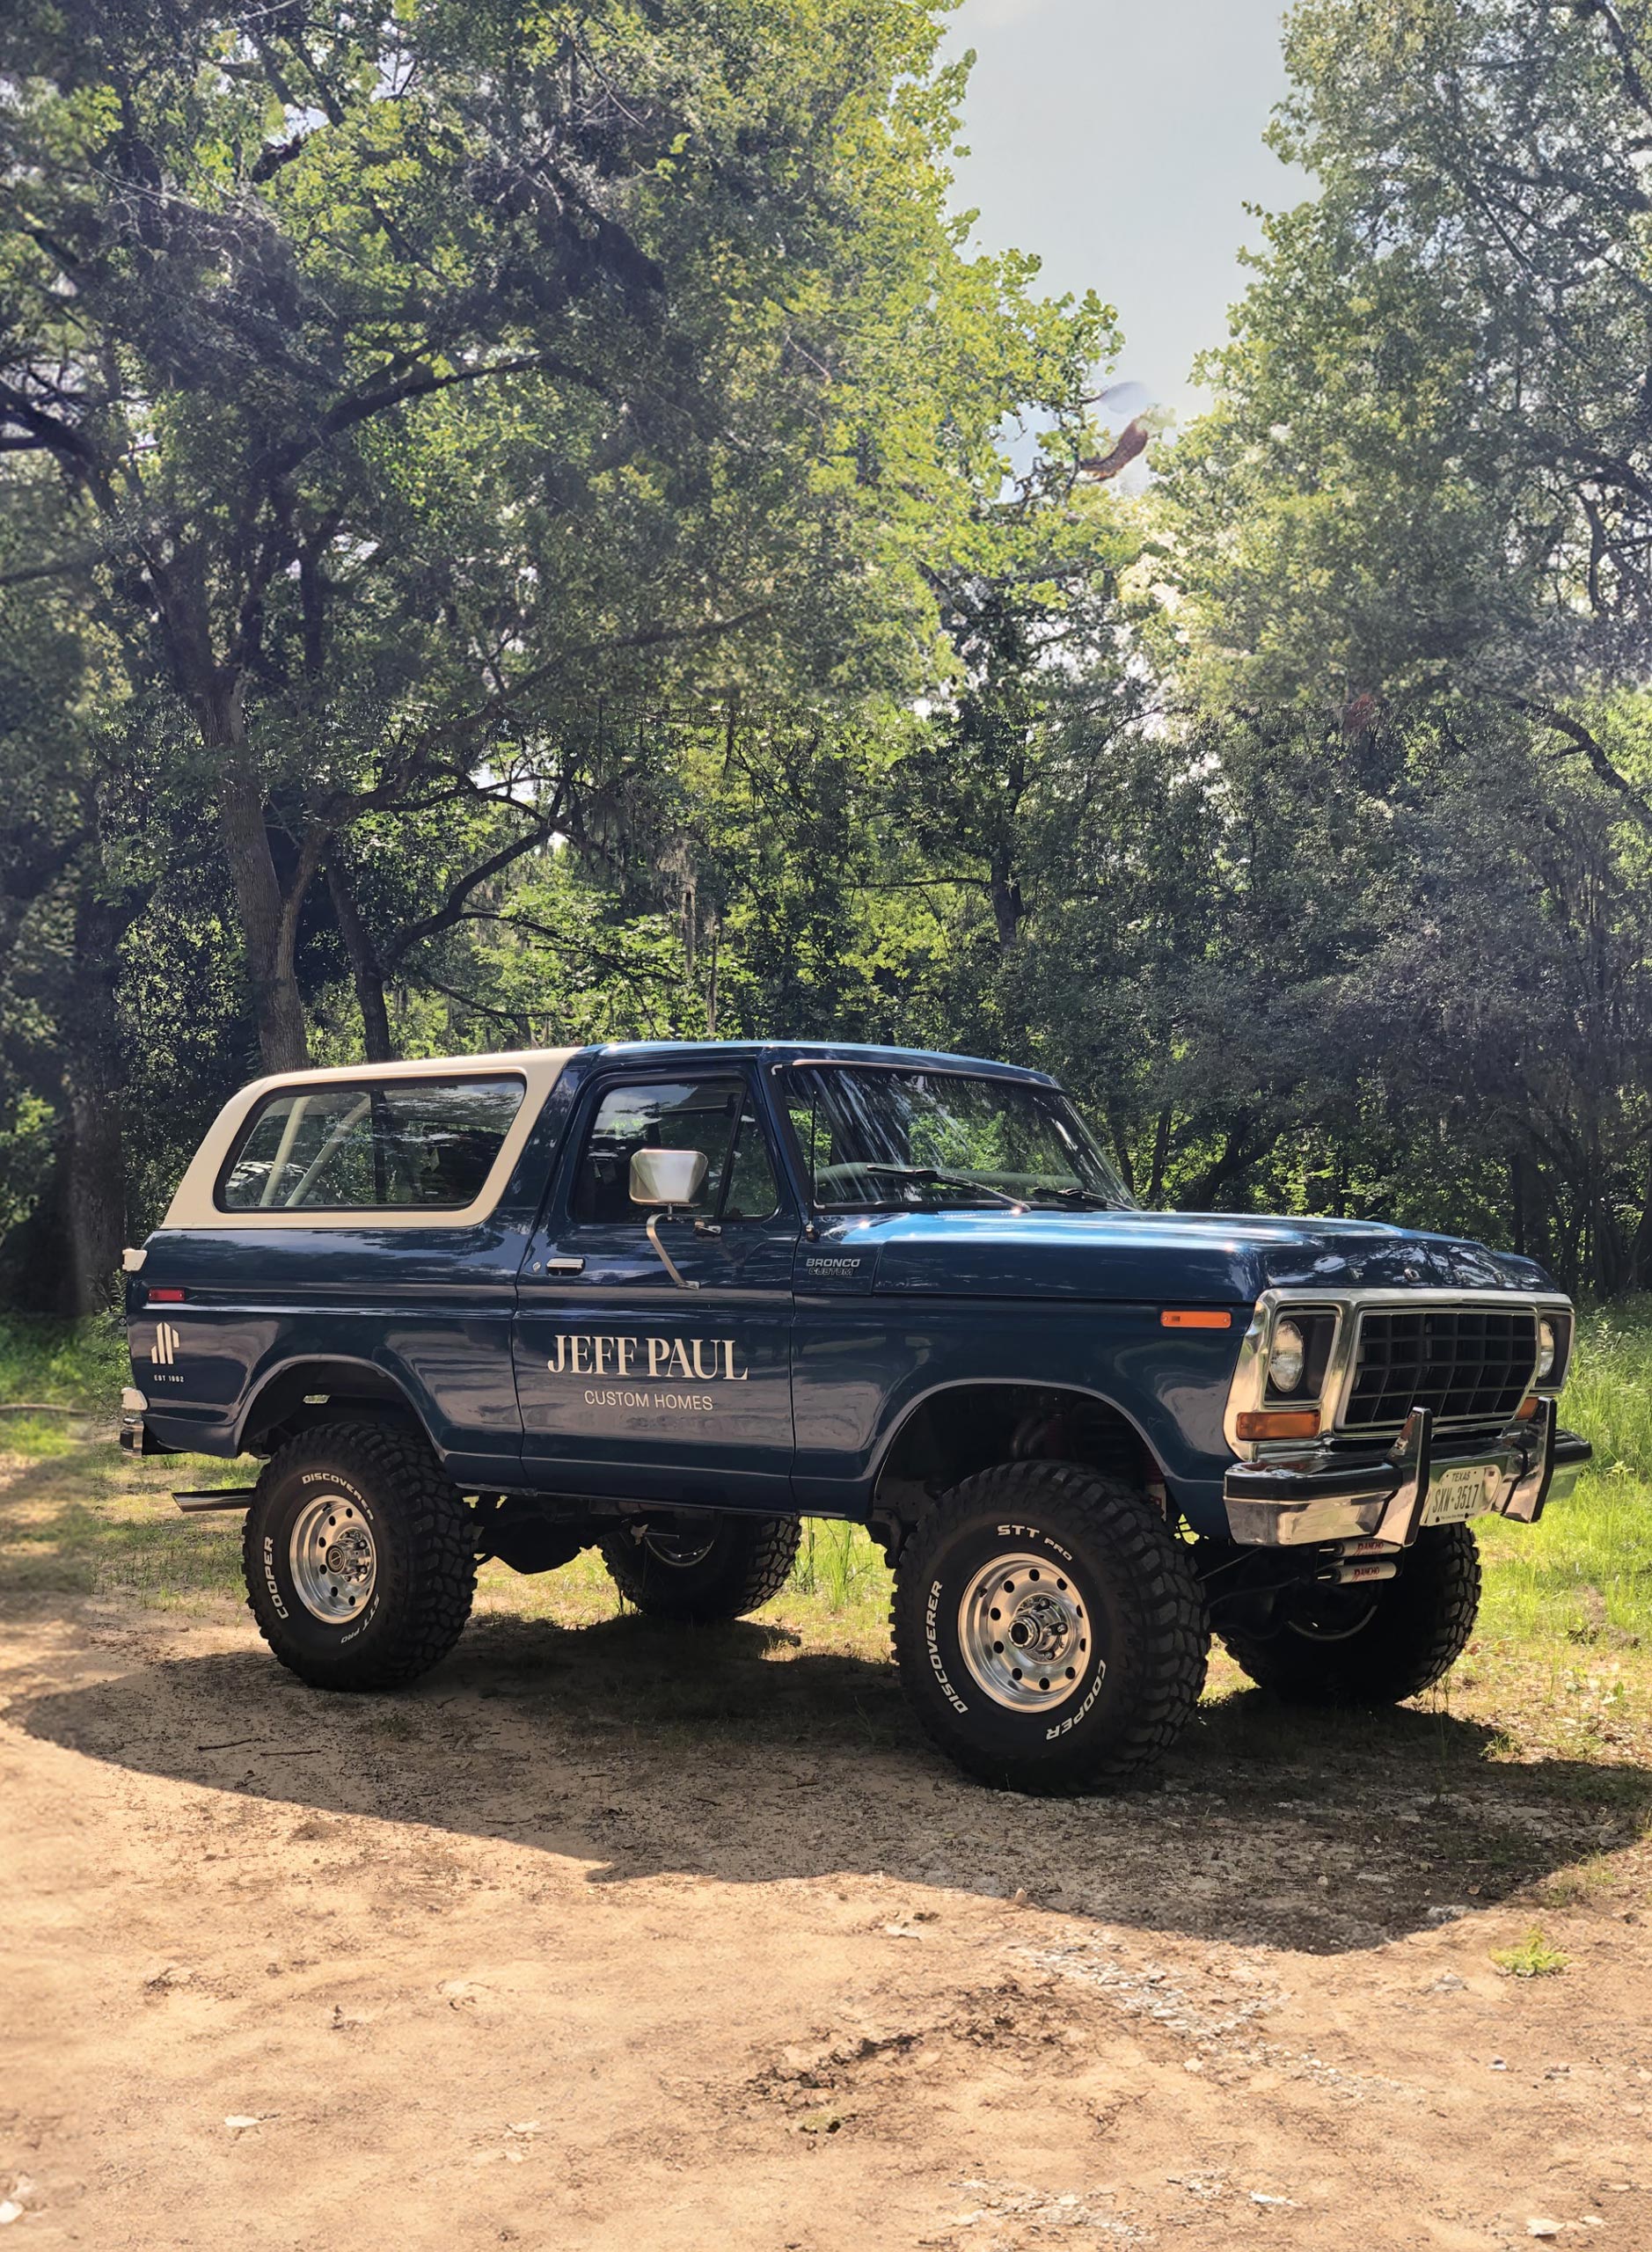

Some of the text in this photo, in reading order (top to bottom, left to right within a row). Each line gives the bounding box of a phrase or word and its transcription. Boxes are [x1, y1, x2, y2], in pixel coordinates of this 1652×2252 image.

[806, 1258, 860, 1267] BRONCO
[547, 1334, 748, 1380] JEFF PAUL
[584, 1390, 713, 1410] CUSTOM HOMES
[302, 1473, 374, 1520] DISCOVERER
[1451, 1471, 1471, 1481] TEXAS
[997, 1524, 1073, 1561] STT PRO
[264, 1536, 289, 1620] COOPER
[362, 1593, 380, 1631] STT
[925, 1580, 969, 1714] DISCOVERER
[1046, 1659, 1107, 1741] COOPER
